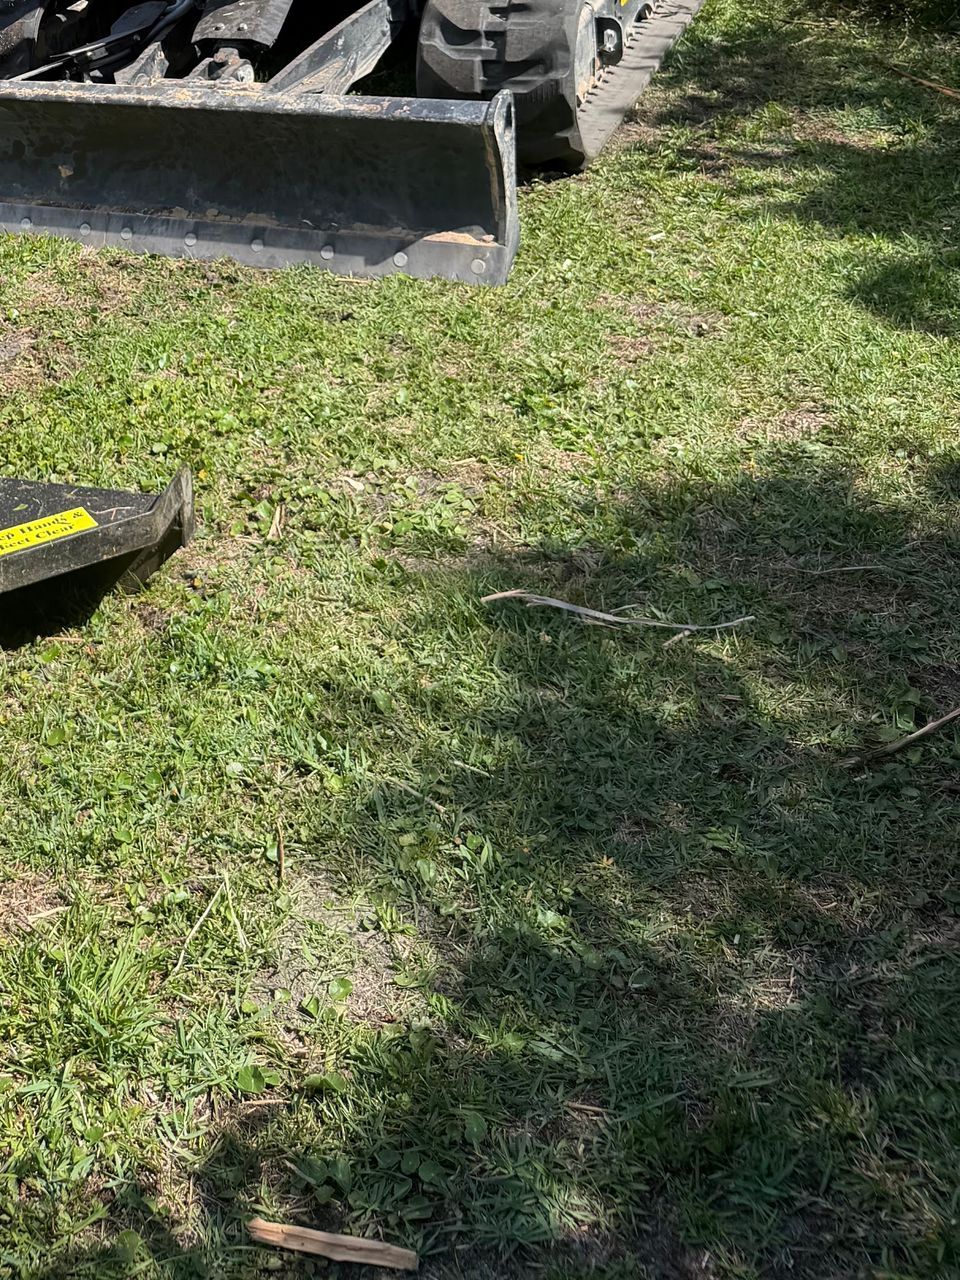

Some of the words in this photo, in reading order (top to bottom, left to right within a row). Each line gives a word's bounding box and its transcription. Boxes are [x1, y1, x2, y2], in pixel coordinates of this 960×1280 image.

[19, 517, 68, 535] Hands
[72, 511, 84, 519] &
[35, 524, 75, 540] Clear
